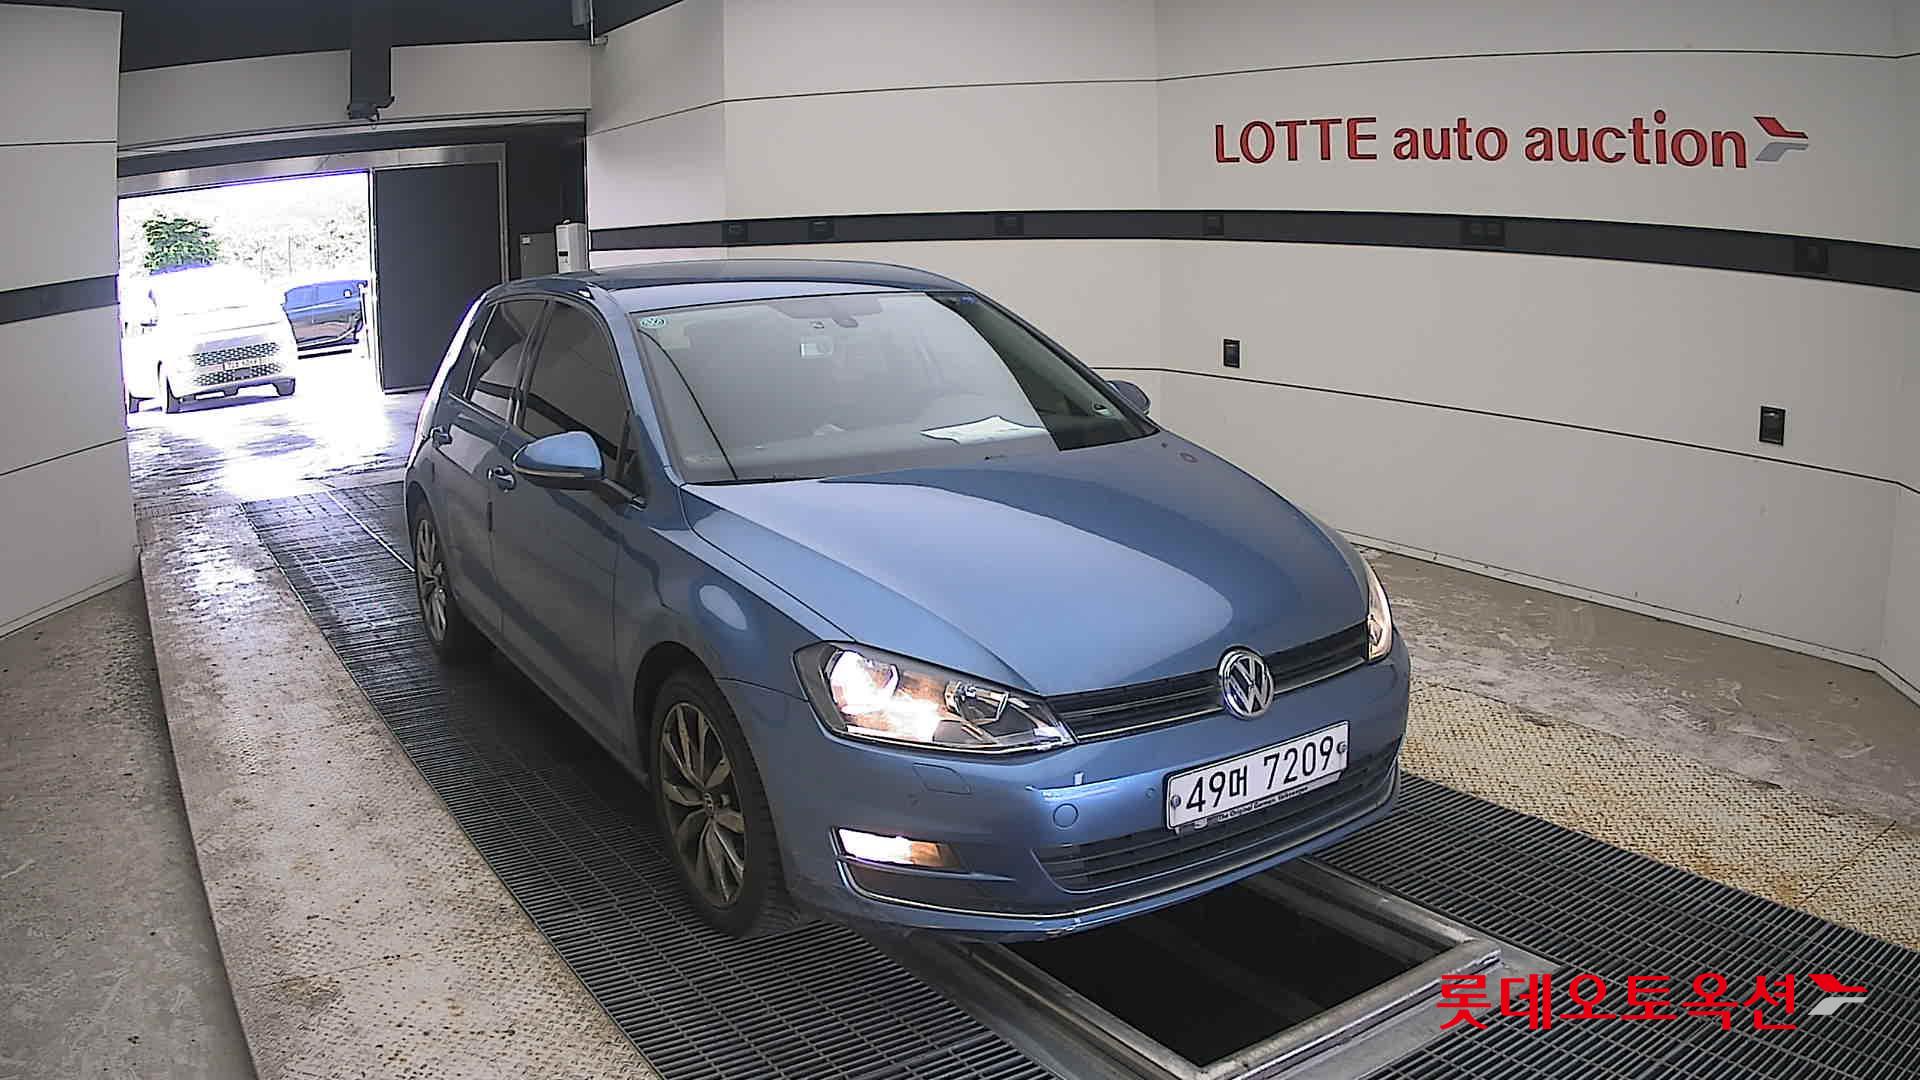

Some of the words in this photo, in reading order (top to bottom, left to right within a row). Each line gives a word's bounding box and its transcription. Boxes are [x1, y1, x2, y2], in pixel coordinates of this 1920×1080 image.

[1215, 116, 1378, 164] LOTTE
[1393, 117, 1508, 162] auto
[1524, 109, 1748, 169] auction
[1186, 764, 1248, 812] 49머
[1263, 735, 1334, 790] 7209
